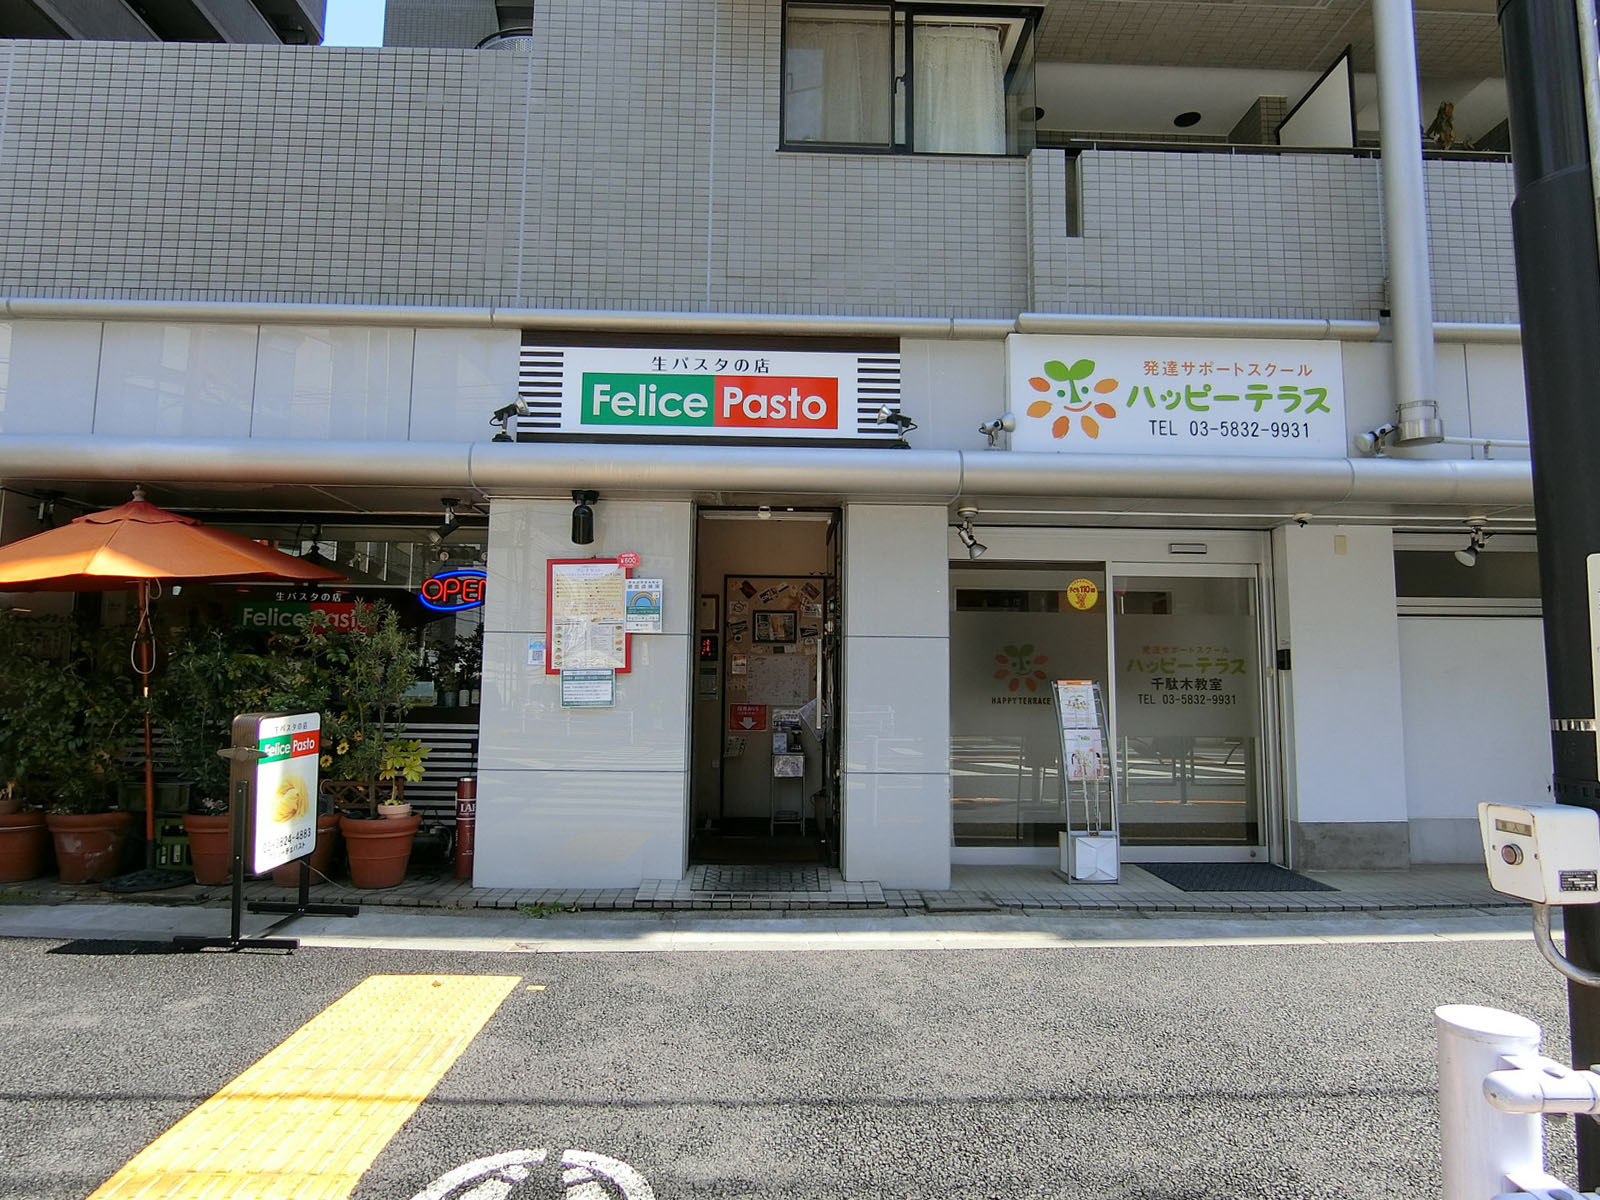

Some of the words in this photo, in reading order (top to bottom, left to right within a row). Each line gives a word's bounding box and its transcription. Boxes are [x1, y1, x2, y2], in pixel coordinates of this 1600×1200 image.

[651, 356, 770, 374] 生パスタの店
[1143, 359, 1313, 378] 発達サポートスクール
[592, 383, 709, 419] Felice
[722, 386, 828, 421] Pasto
[1126, 383, 1331, 415] ハッピーテラス
[1148, 419, 1178, 437] TEL
[1189, 420, 1310, 438] 03-5832-9931
[275, 591, 341, 602] 生パスタの店
[242, 607, 306, 627] Felice
[1126, 657, 1246, 675] ハッピーテラス
[1151, 677, 1223, 691] 千駄木教室
[1137, 693, 1156, 705] TEL
[1162, 694, 1237, 705] 03-5832-9931
[264, 742, 291, 757] Felice
[292, 737, 315, 752] Pasto
